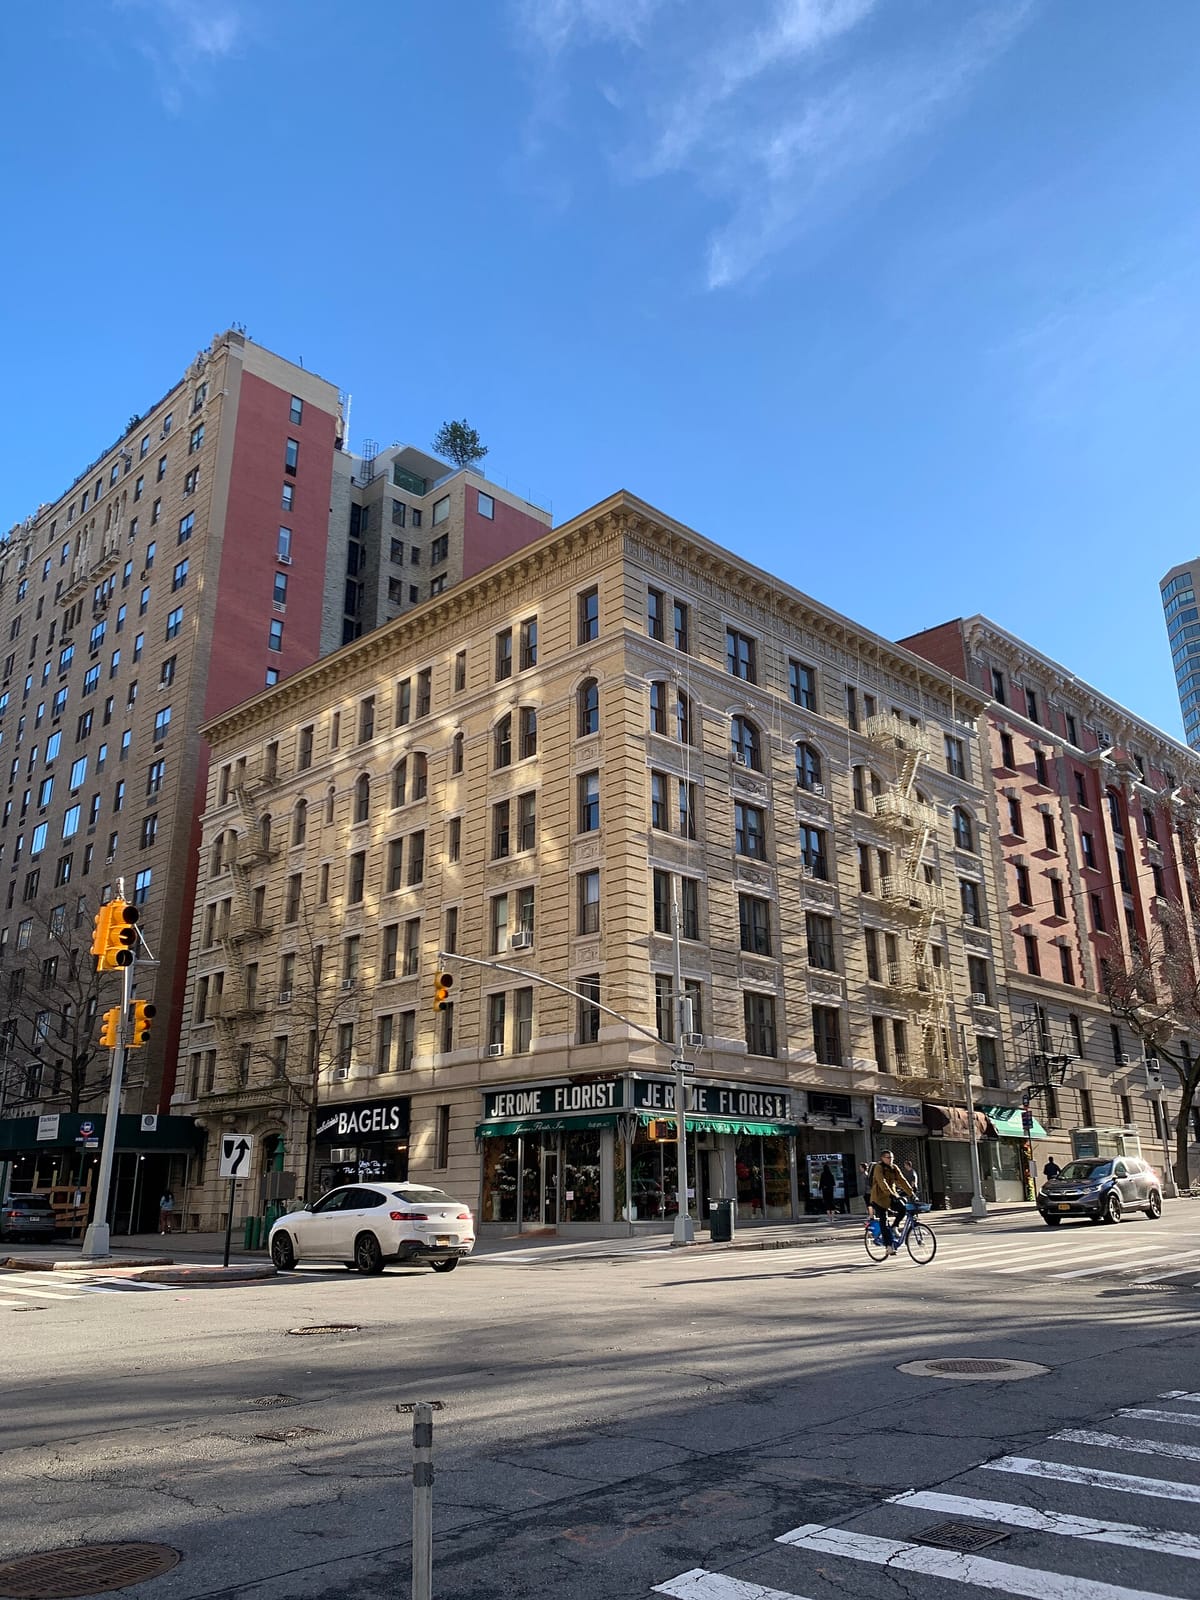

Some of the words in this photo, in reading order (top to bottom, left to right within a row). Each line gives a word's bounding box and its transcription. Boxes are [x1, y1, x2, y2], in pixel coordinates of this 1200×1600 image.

[491, 1091, 541, 1117] JEROME
[554, 1083, 615, 1111] FLORIST
[642, 1083, 707, 1111] JERME
[719, 1092, 782, 1117] FLORIST
[338, 1106, 399, 1134] BAGELS
